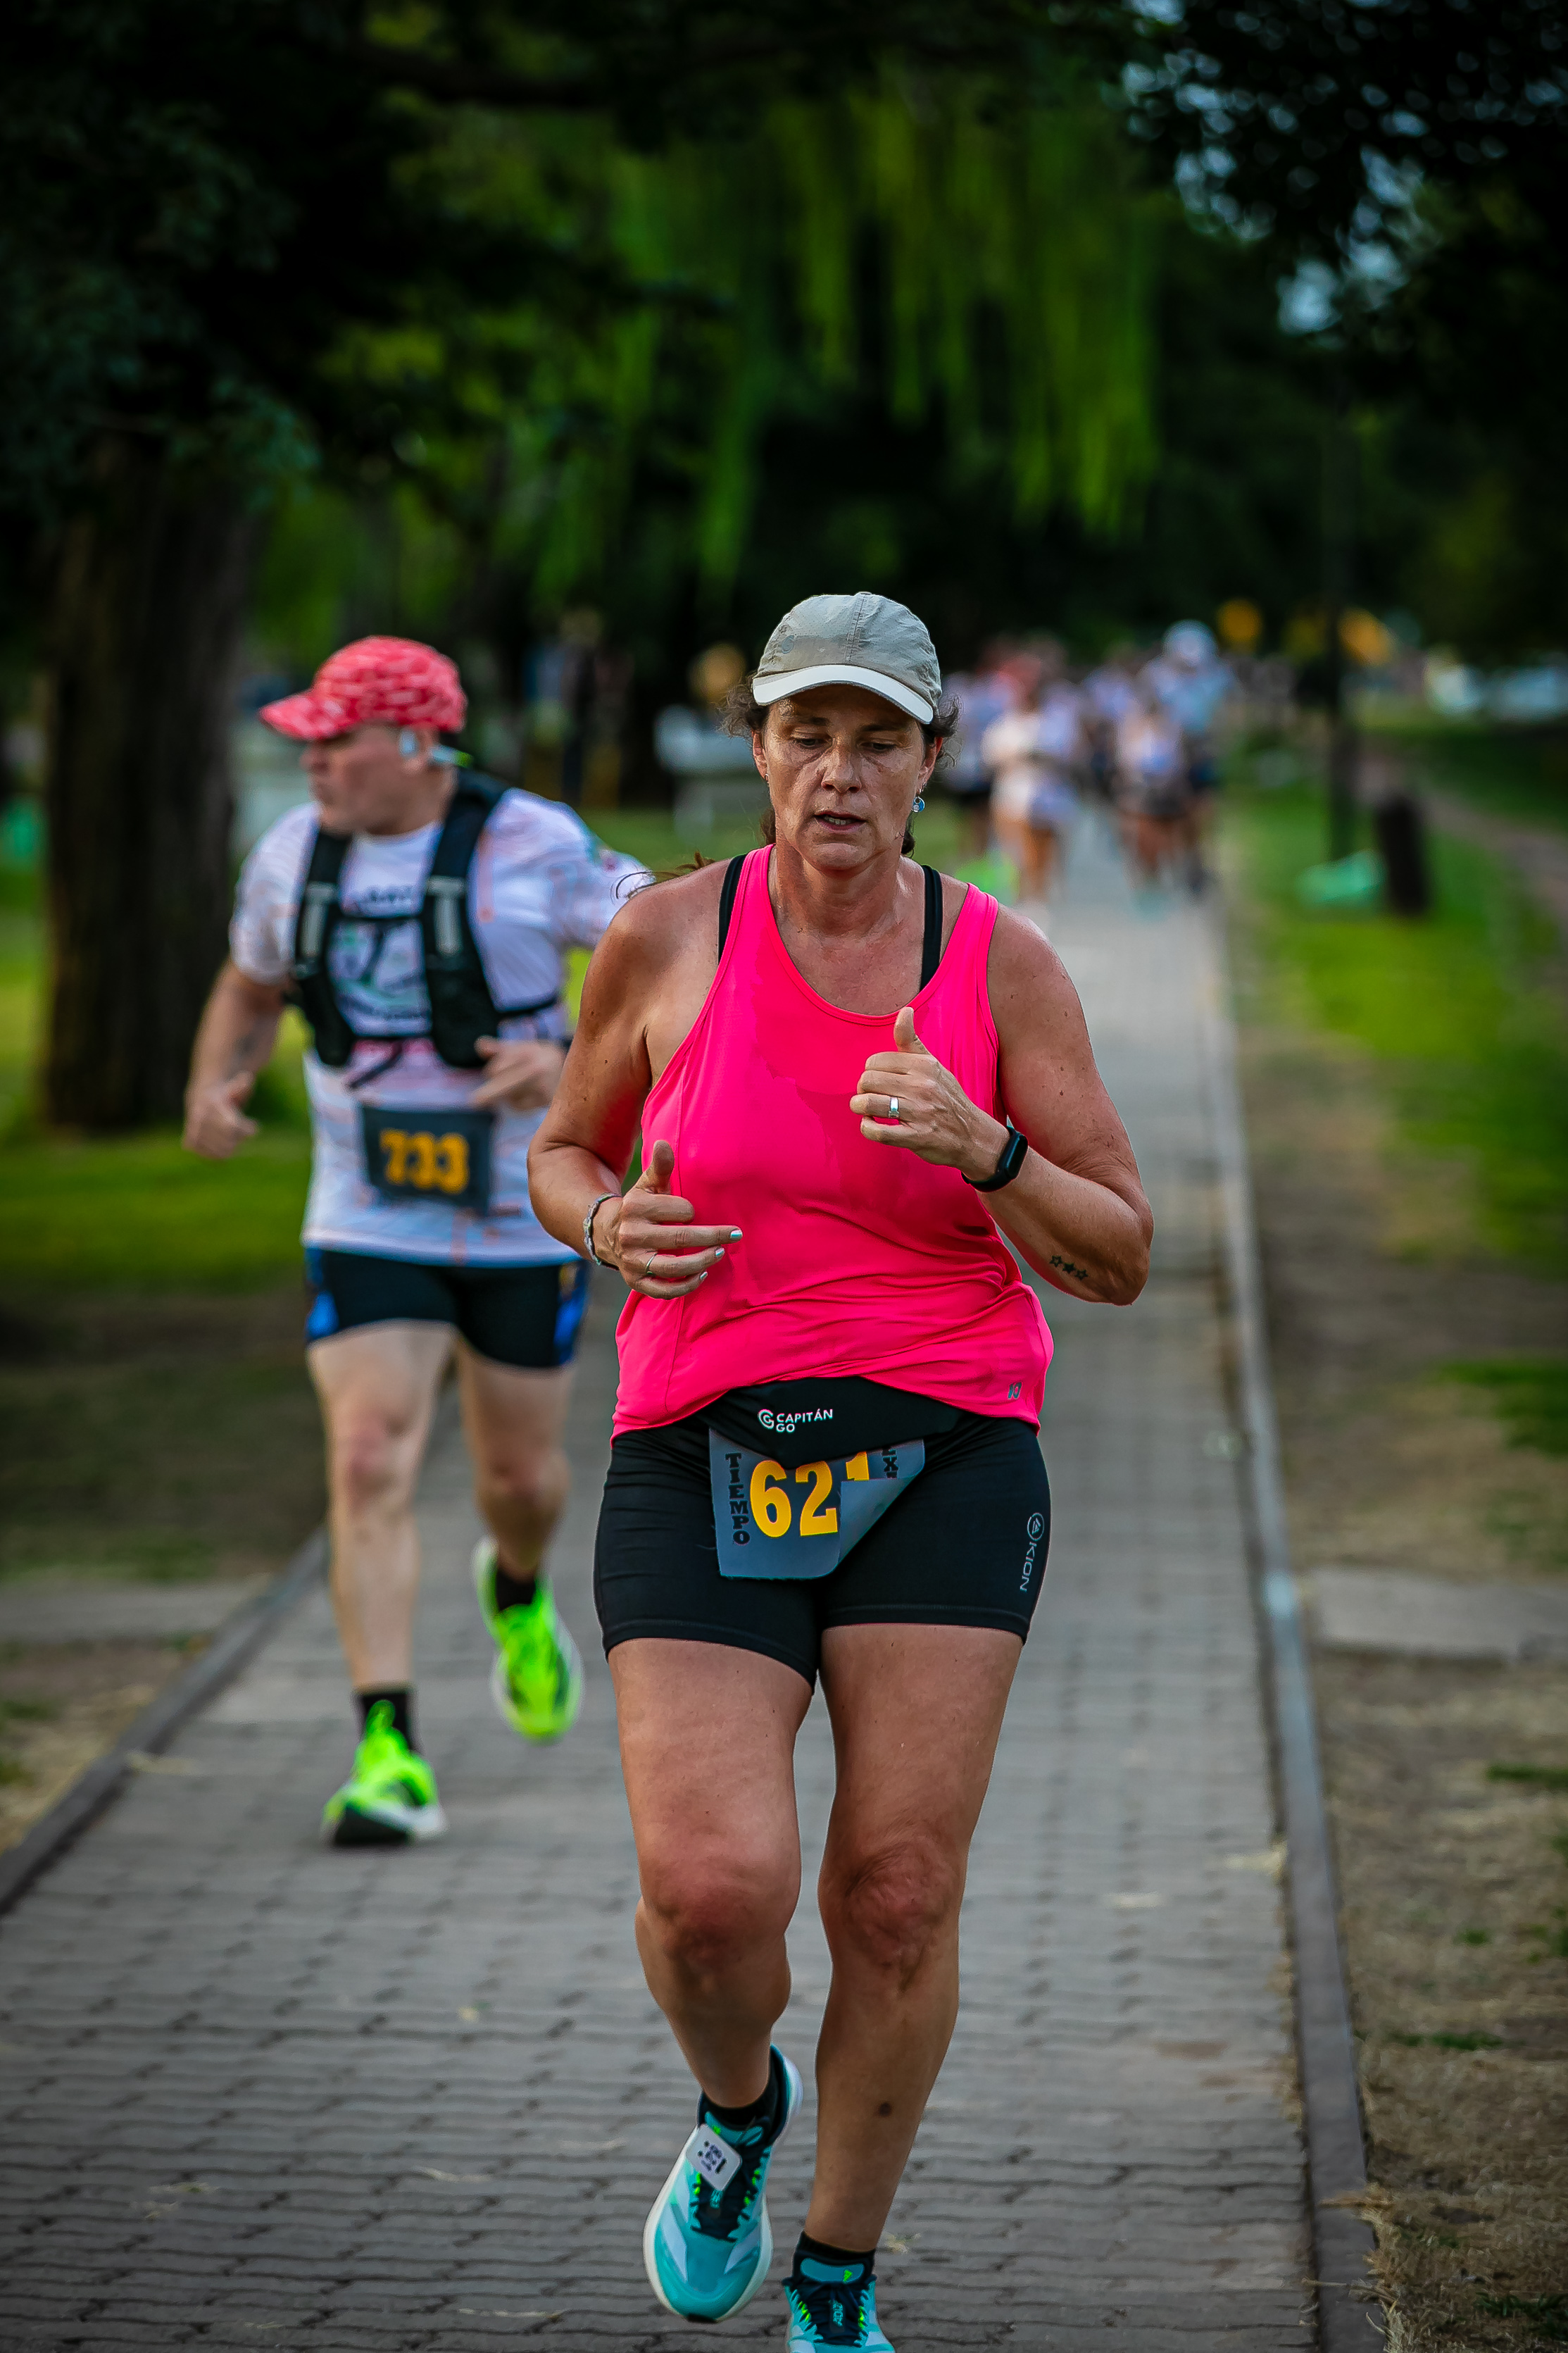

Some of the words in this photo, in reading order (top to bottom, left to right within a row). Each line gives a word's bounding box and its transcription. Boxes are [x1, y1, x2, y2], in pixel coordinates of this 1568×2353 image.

[380, 1129, 469, 1194] 733
[776, 1423, 796, 1433] GO
[777, 1409, 833, 1423] CAPITÁN
[725, 1452, 750, 1546] TIEMPO
[1020, 1542, 1037, 1592] KION
